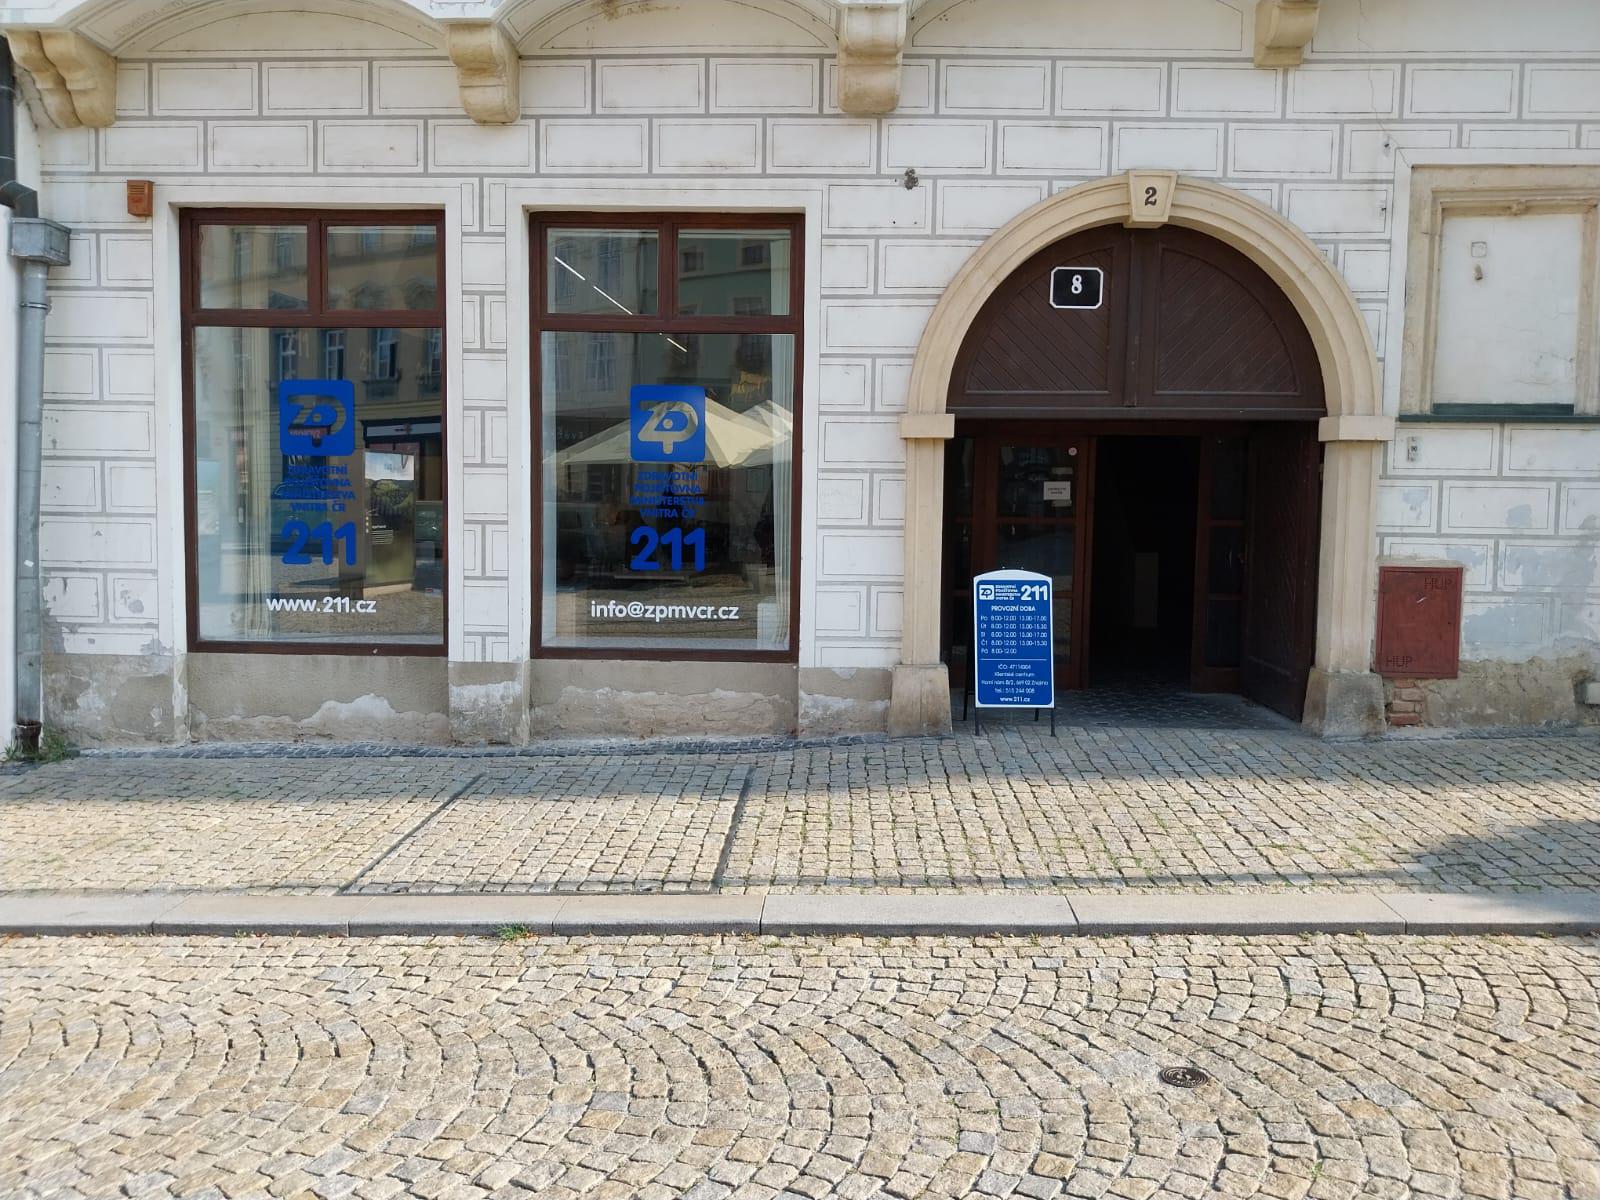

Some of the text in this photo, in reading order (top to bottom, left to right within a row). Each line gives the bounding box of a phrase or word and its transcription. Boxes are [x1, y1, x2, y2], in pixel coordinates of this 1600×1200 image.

[1144, 186, 1157, 206] 2
[1071, 274, 1082, 294] 8
[282, 520, 357, 566] 211
[630, 525, 705, 572] 211
[1021, 585, 1048, 601] 211
[1423, 577, 1453, 591] HUP
[266, 596, 377, 613] www.211.cz
[591, 600, 740, 623] info@zpmvcr.cz
[1384, 655, 1413, 668] HUP
